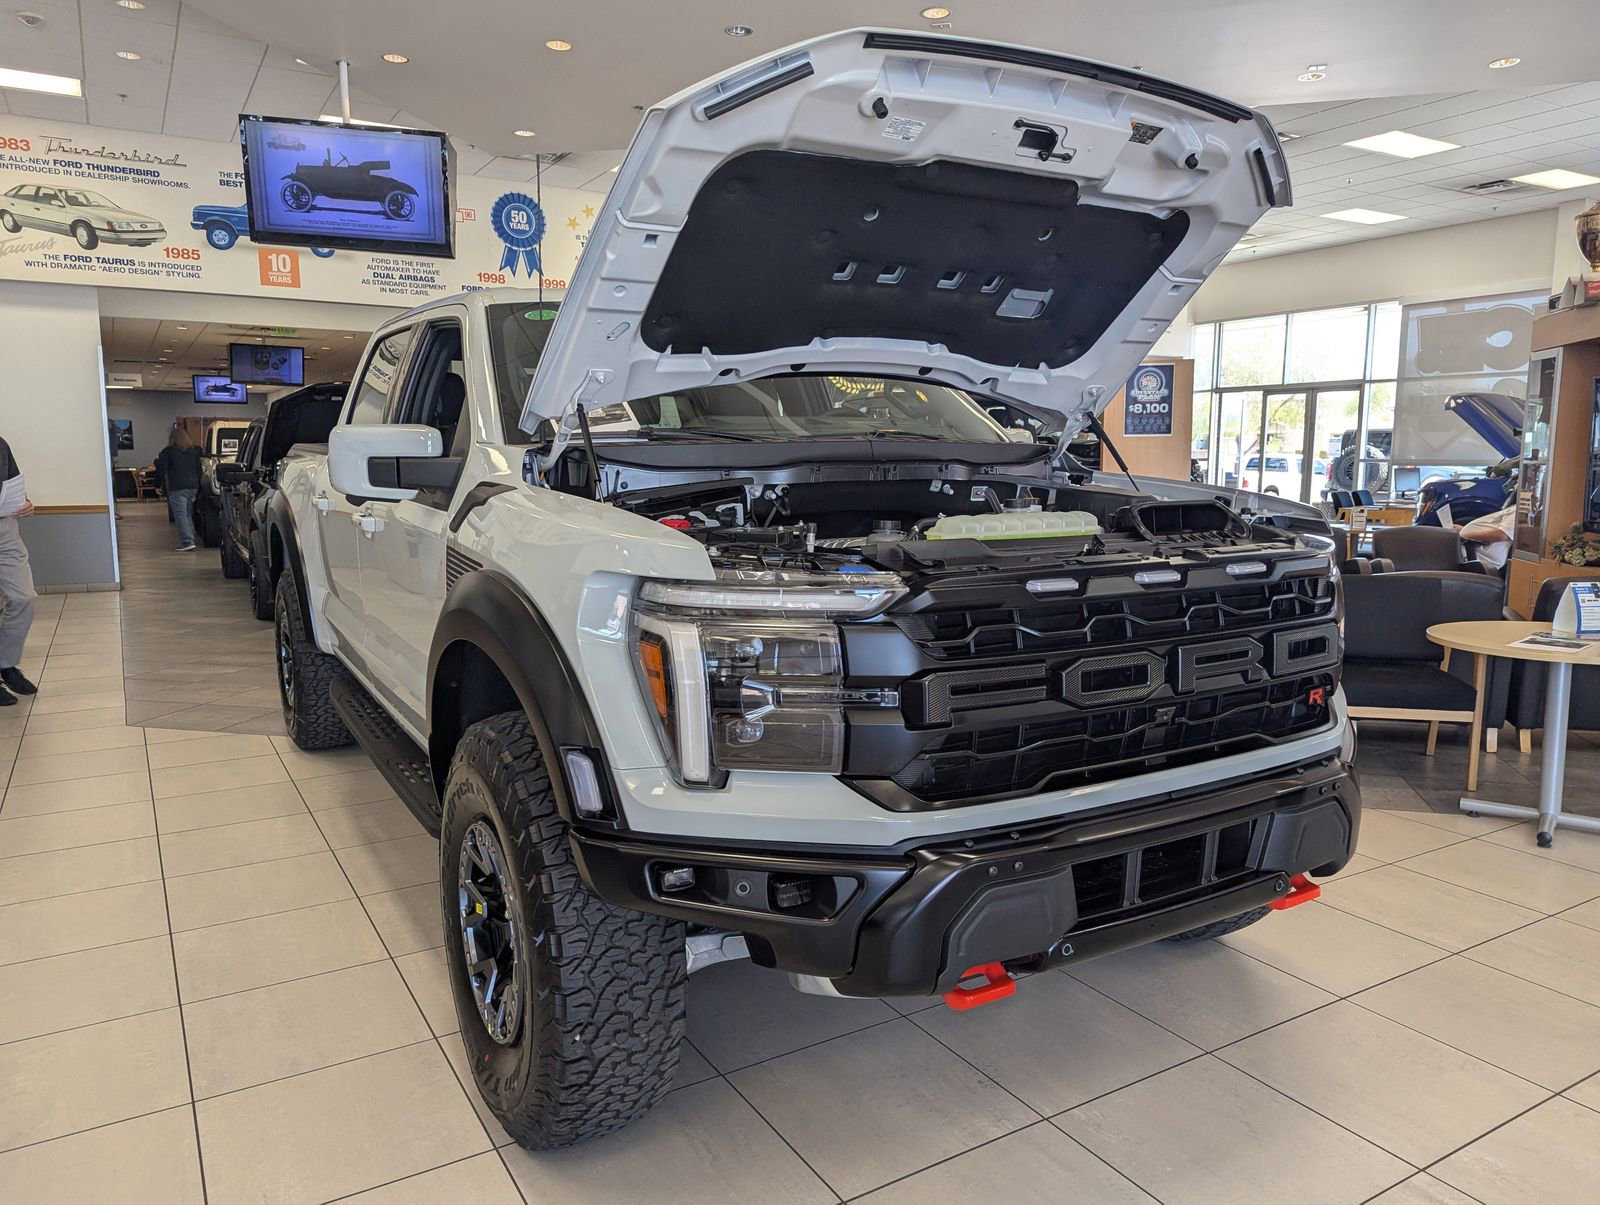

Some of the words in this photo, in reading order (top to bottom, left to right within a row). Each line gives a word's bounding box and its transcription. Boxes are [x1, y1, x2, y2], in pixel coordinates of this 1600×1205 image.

[0, 136, 31, 151] 983
[38, 135, 187, 167] Thunderbird
[8, 155, 50, 165] ALL-NEW
[53, 159, 83, 169] FORD
[85, 163, 160, 177] THUNDERBIRD
[0, 163, 60, 175] INTRODUCED
[74, 171, 130, 182] DEALERSHIP
[131, 177, 191, 189] SHOWROOMS.
[235, 172, 245, 180] FO
[219, 179, 243, 188] BEST
[511, 210, 527, 223] 50
[509, 222, 529, 231] YEARS
[163, 247, 200, 260] 1985
[63, 254, 92, 262] FORD
[95, 256, 135, 266] TAURUS
[148, 261, 202, 271] INTRODUCED
[268, 253, 291, 273] 10
[24, 260, 47, 268] WITH
[50, 262, 96, 272] DRAMATIC
[99, 265, 126, 273] "AERO
[128, 267, 163, 276] DESIGN"
[165, 271, 202, 279] STYLING.
[367, 264, 410, 274] AUTOMAKER
[269, 275, 292, 284] YEARS
[373, 272, 396, 280] DUAL
[399, 274, 435, 283] AIRBAGS
[477, 272, 506, 284] 1998
[540, 277, 566, 289] 1999
[372, 280, 407, 288] STANDARD
[409, 282, 447, 291] EQUIPMENT
[389, 287, 408, 295] MOST
[1128, 403, 1169, 414] $8,100
[922, 622, 1340, 724] FORD
[1309, 687, 1324, 705] R
